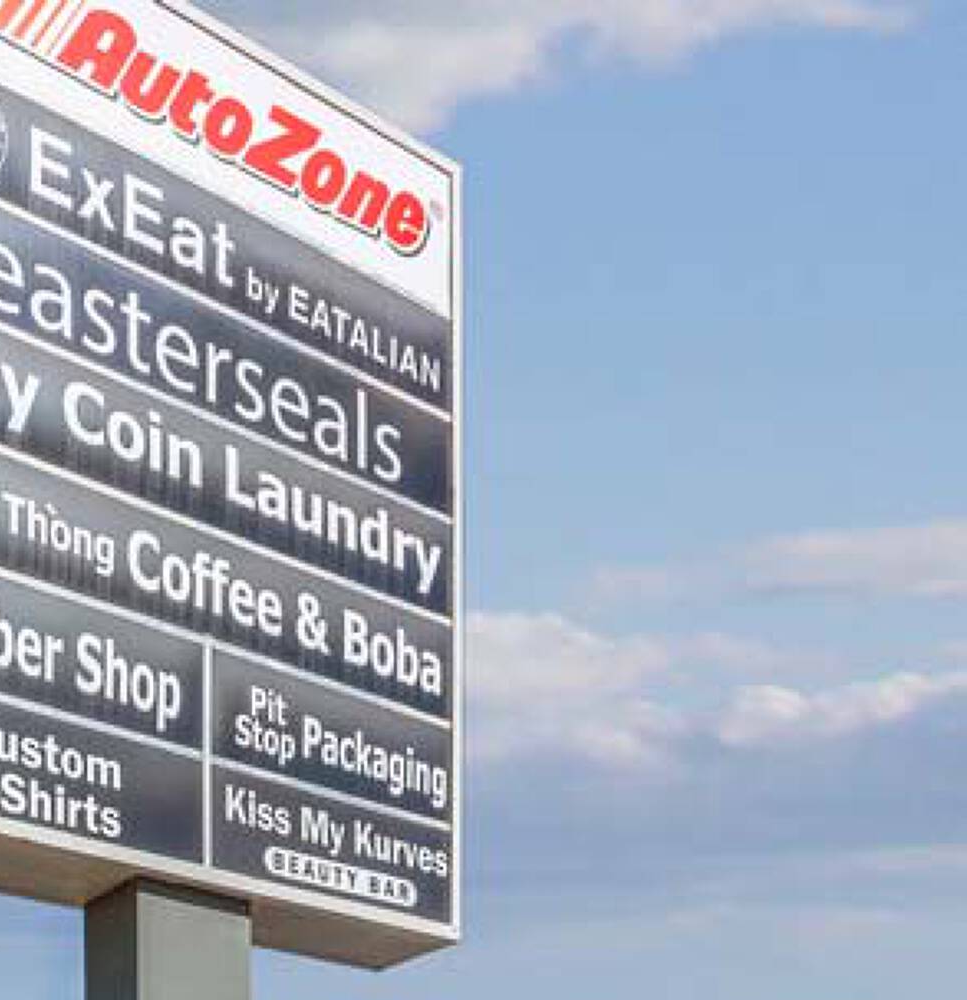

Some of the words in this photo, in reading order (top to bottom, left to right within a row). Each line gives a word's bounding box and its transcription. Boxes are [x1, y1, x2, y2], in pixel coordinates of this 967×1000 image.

[55, 6, 428, 250] AutoZone
[29, 125, 236, 288] ExEat
[245, 268, 280, 315] by
[287, 289, 442, 392] EATALIAN
[63, 382, 204, 488] Coin
[225, 447, 442, 594] Laundry
[129, 530, 284, 637] Coffee
[297, 595, 330, 655] &
[343, 610, 443, 697] Boba
[76, 634, 183, 731] Shop
[250, 685, 288, 727] Pit
[234, 714, 297, 766] Stop
[301, 722, 448, 809] Packaging
[224, 783, 291, 835] Kiss
[300, 806, 345, 855] My
[353, 819, 448, 878] Kurves
[274, 849, 358, 890] BEAUTY
